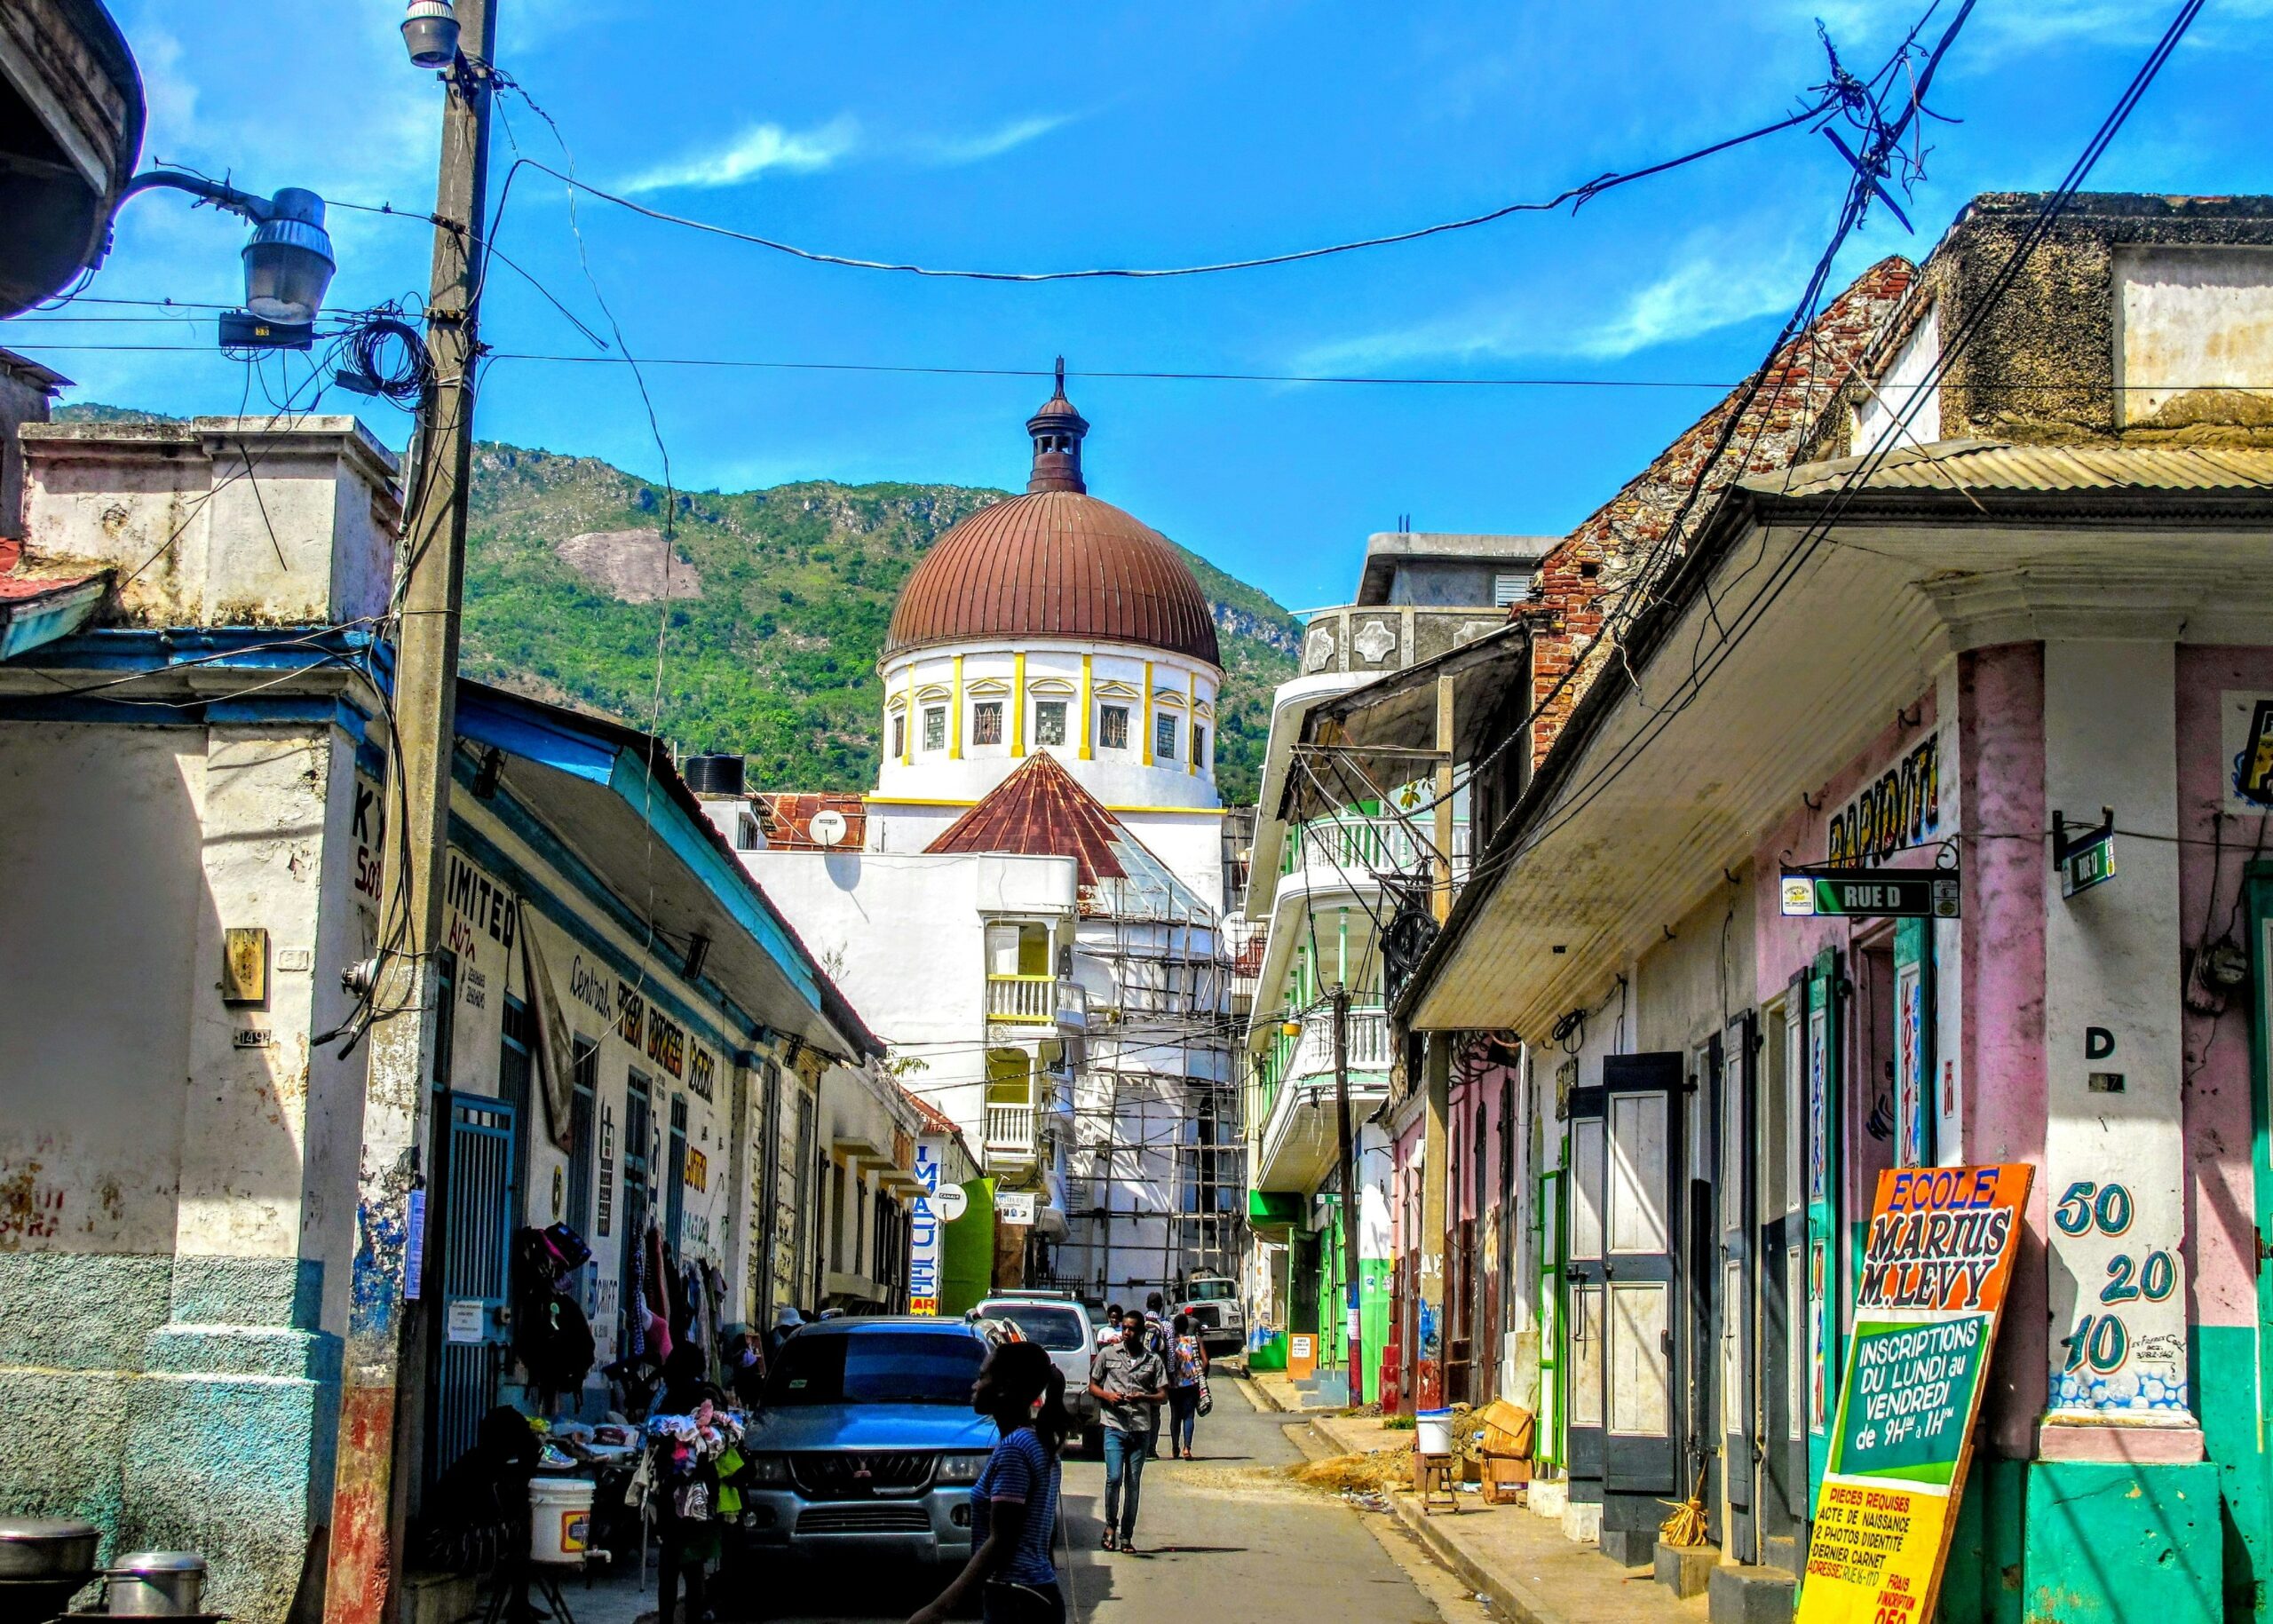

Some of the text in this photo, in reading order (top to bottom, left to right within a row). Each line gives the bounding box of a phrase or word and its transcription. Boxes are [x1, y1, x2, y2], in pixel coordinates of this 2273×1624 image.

[1844, 885, 1901, 907] RUE D
[2086, 1026, 2115, 1059] D
[1888, 1168, 2000, 1211] ECOLE
[2055, 1182, 2134, 1237] 50
[1867, 1208, 2011, 1263] MARIUS
[2100, 1250, 2177, 1306] 20
[1858, 1319, 1978, 1368] INSCRIPTIONS
[2061, 1313, 2129, 1375] 10
[1860, 1353, 1967, 1394] DU LUNDI au
[1866, 1380, 1951, 1421] VENDREDI
[1856, 1422, 1876, 1451] de
[1829, 1487, 1911, 1514] PIECES REQUISES
[1824, 1526, 1860, 1547] PHOTOS
[1847, 1509, 1858, 1525] DE
[1862, 1511, 1911, 1533] NAISSANCE
[1812, 1543, 1887, 1570] DERNIER CARNET
[1887, 1573, 1911, 1592] FRAIS
